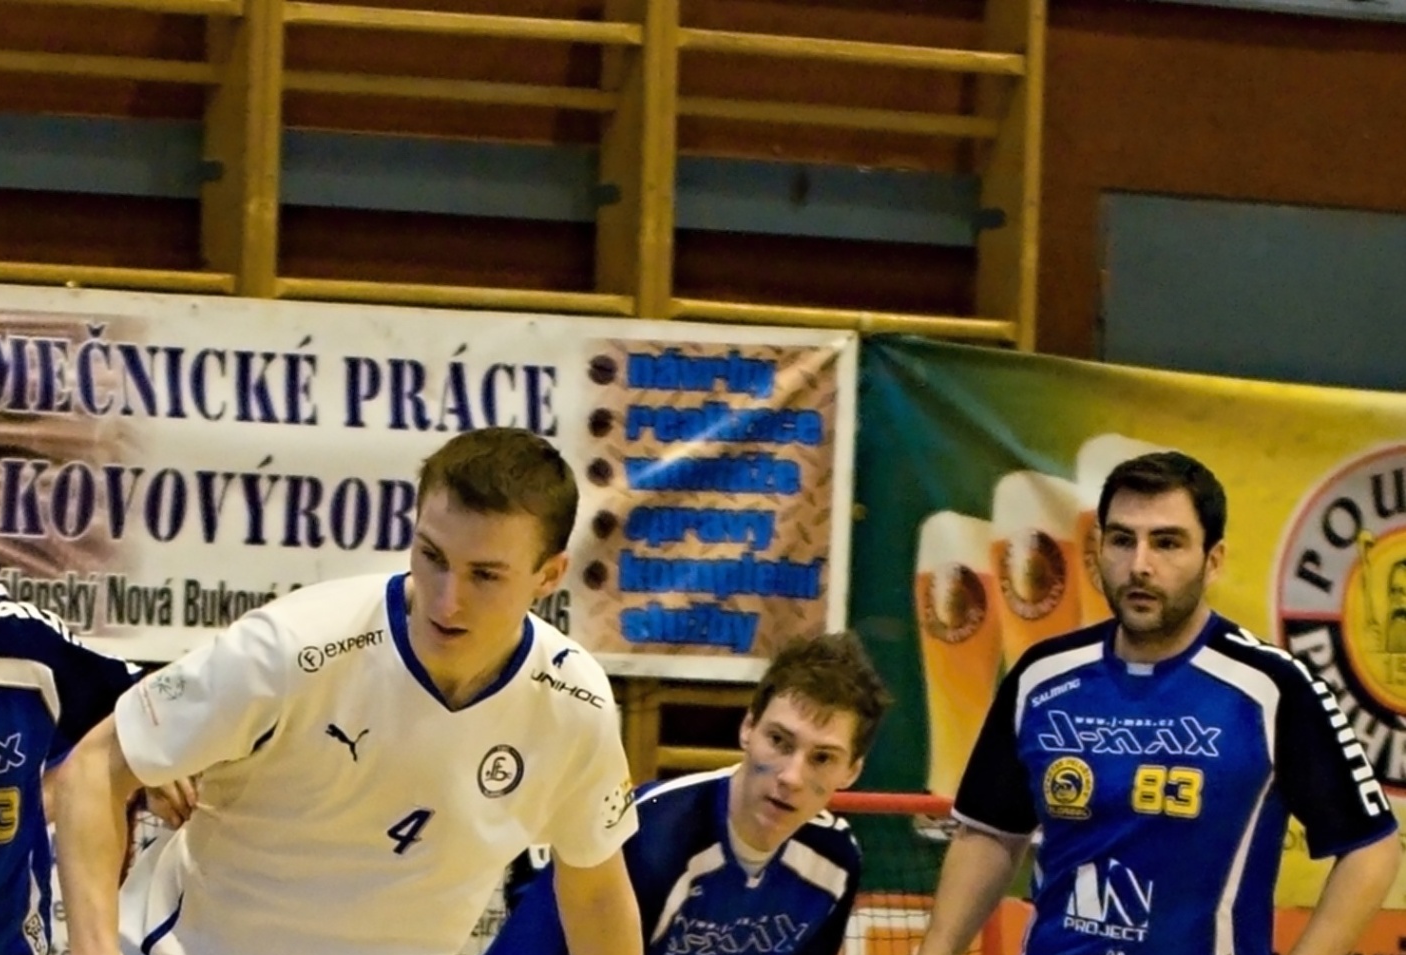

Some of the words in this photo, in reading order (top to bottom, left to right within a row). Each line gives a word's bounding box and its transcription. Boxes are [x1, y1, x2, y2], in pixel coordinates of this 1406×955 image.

[342, 343, 557, 436] PRÁCE
[106, 575, 173, 627] Nová
[529, 669, 606, 710] UNIHOC
[1131, 764, 1205, 819] 83
[387, 807, 435, 855] 4
[1063, 916, 1149, 942] PROJECT
